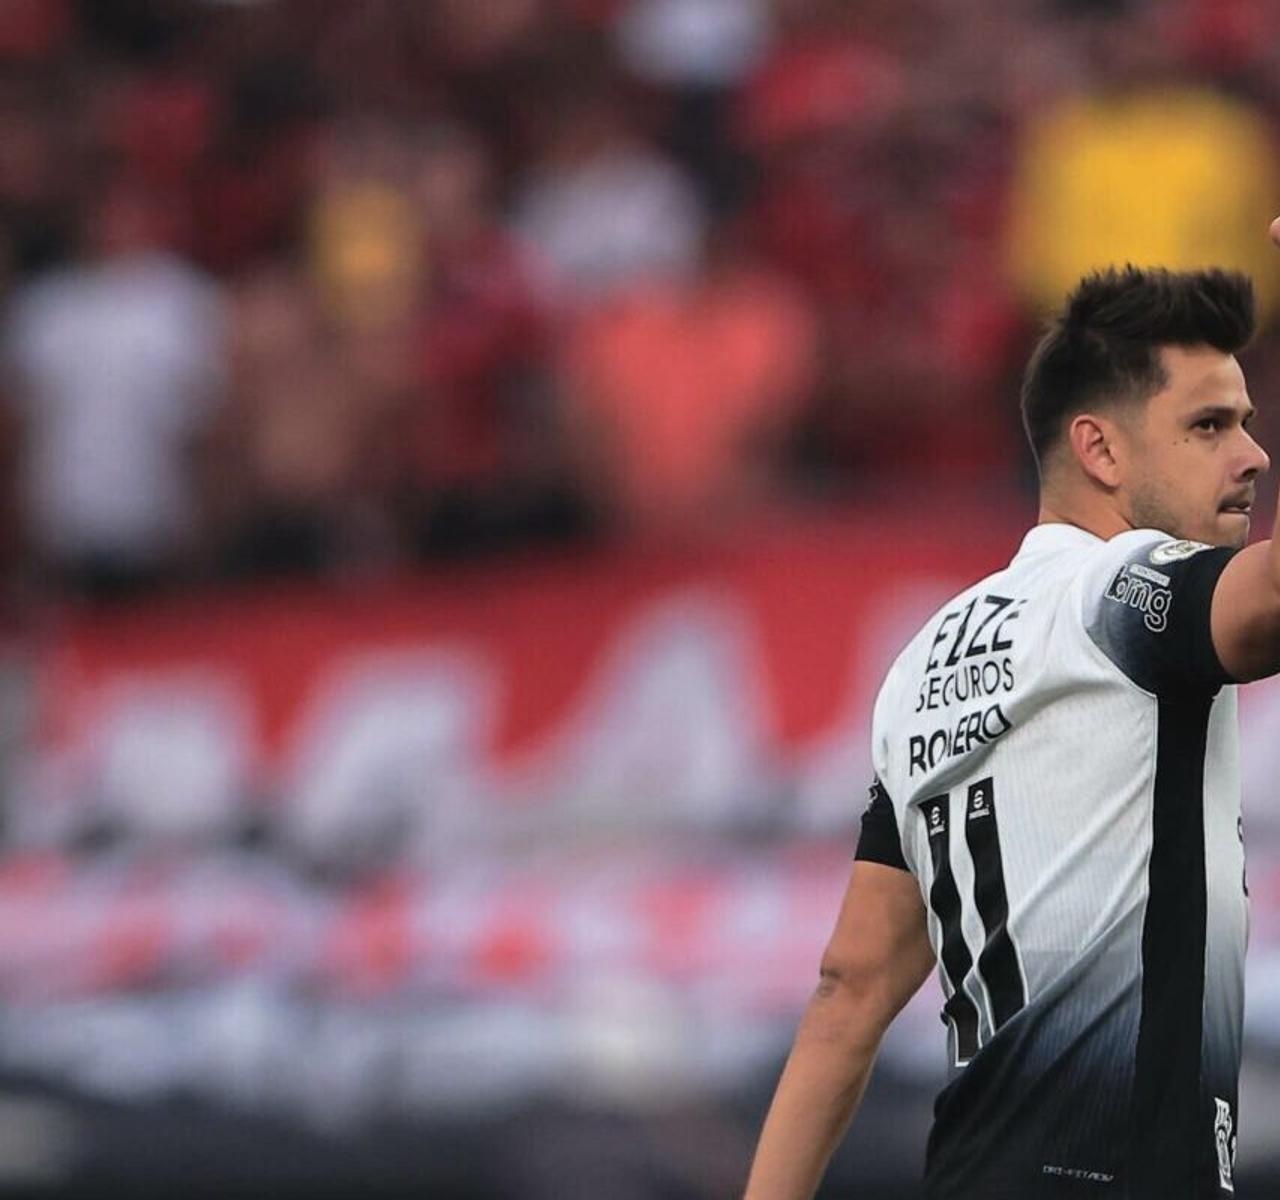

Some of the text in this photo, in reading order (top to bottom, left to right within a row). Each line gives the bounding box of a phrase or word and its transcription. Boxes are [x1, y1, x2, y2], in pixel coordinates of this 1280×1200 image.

[1104, 563, 1172, 632] bmg
[910, 703, 1012, 776] ROERO
[918, 776, 1029, 1066] 11
